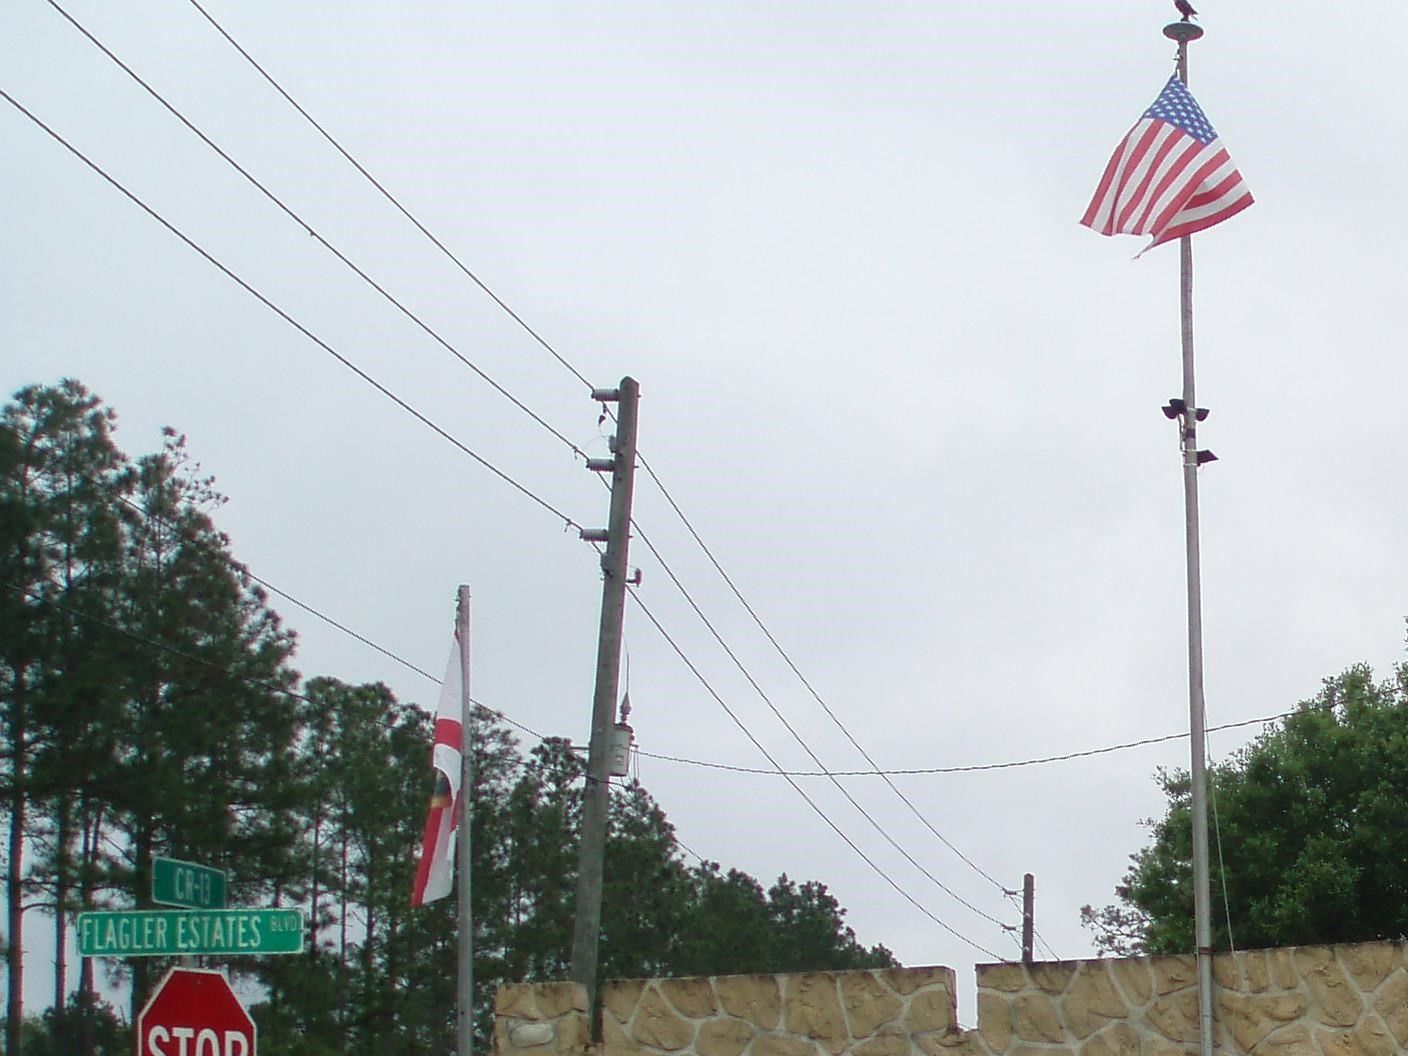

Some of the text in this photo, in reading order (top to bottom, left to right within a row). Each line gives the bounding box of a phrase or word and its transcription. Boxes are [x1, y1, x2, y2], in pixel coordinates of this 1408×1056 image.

[82, 914, 298, 949] FLAGLER ESTATES BLVD
